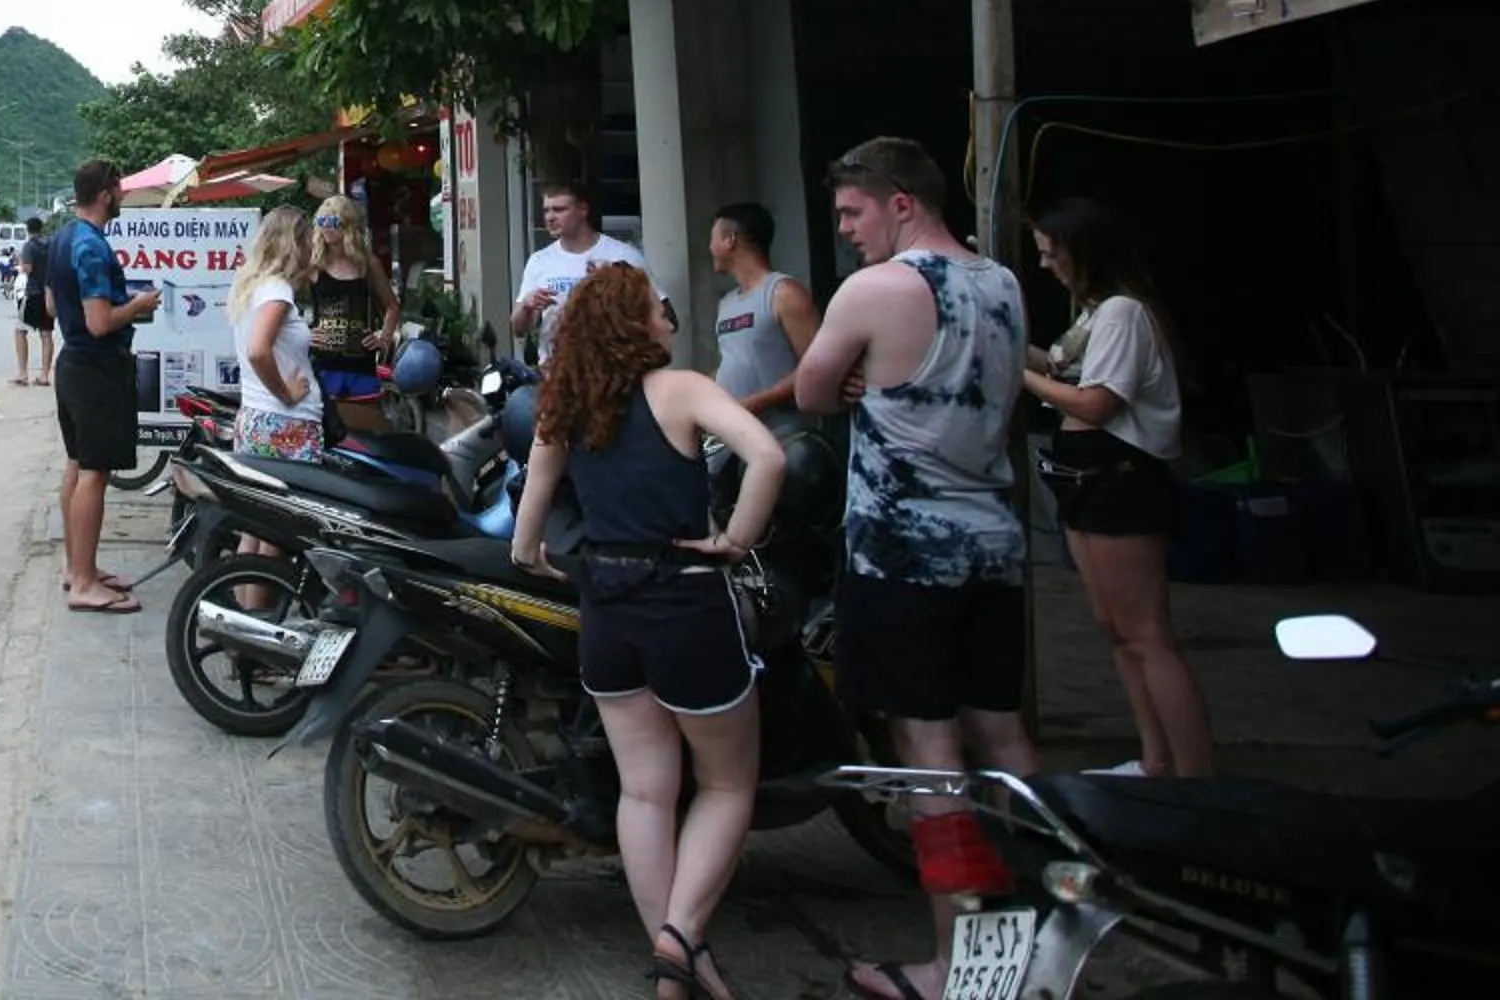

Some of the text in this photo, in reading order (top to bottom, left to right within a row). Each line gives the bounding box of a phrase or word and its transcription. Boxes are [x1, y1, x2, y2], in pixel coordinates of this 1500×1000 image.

[127, 217, 169, 238] HÀNG
[174, 217, 211, 243] ĐIỆN
[214, 218, 250, 239] MÁY
[114, 243, 198, 271] OÀNG
